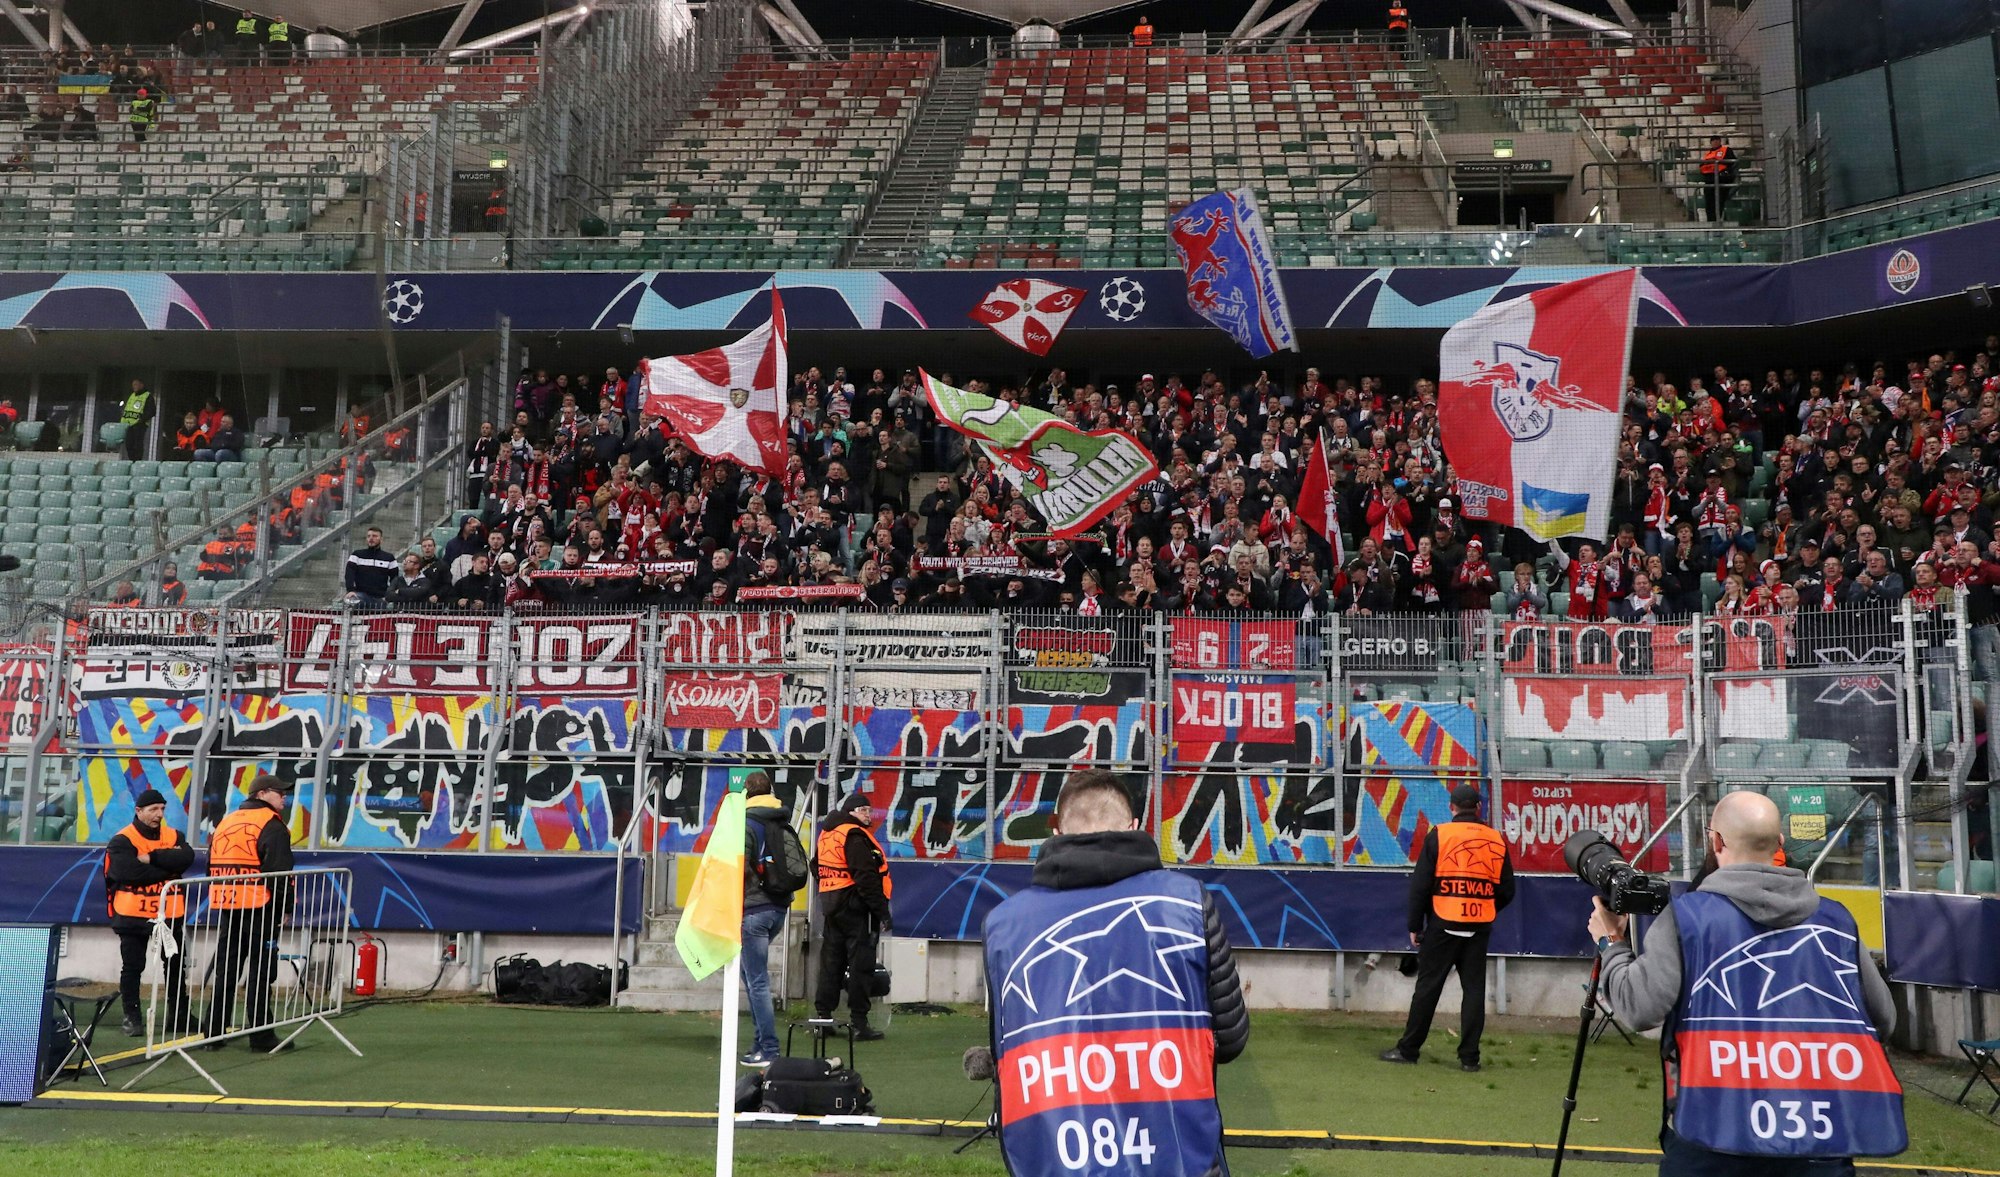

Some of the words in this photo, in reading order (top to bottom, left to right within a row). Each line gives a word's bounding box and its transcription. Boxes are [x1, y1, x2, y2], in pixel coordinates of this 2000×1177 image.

[919, 557, 943, 568] YOUTH
[945, 557, 965, 568] WITH
[969, 567, 1017, 577] ZONE
[741, 589, 776, 597] YOUTH
[799, 587, 860, 597] GENERATION
[1344, 637, 1408, 655] GERO
[1414, 638, 1436, 656] B.
[1177, 690, 1286, 729] BLOCK
[1532, 785, 1572, 798] LEIPZIG
[1791, 795, 1802, 805] W
[1810, 795, 1822, 805] 20
[1502, 801, 1649, 858] asenande
[1460, 902, 1483, 917] 101
[1709, 1040, 1864, 1081] PHOTO
[1017, 1039, 1183, 1105] PHOTO
[1750, 1098, 1834, 1140] 035
[1056, 1116, 1157, 1170] 084
